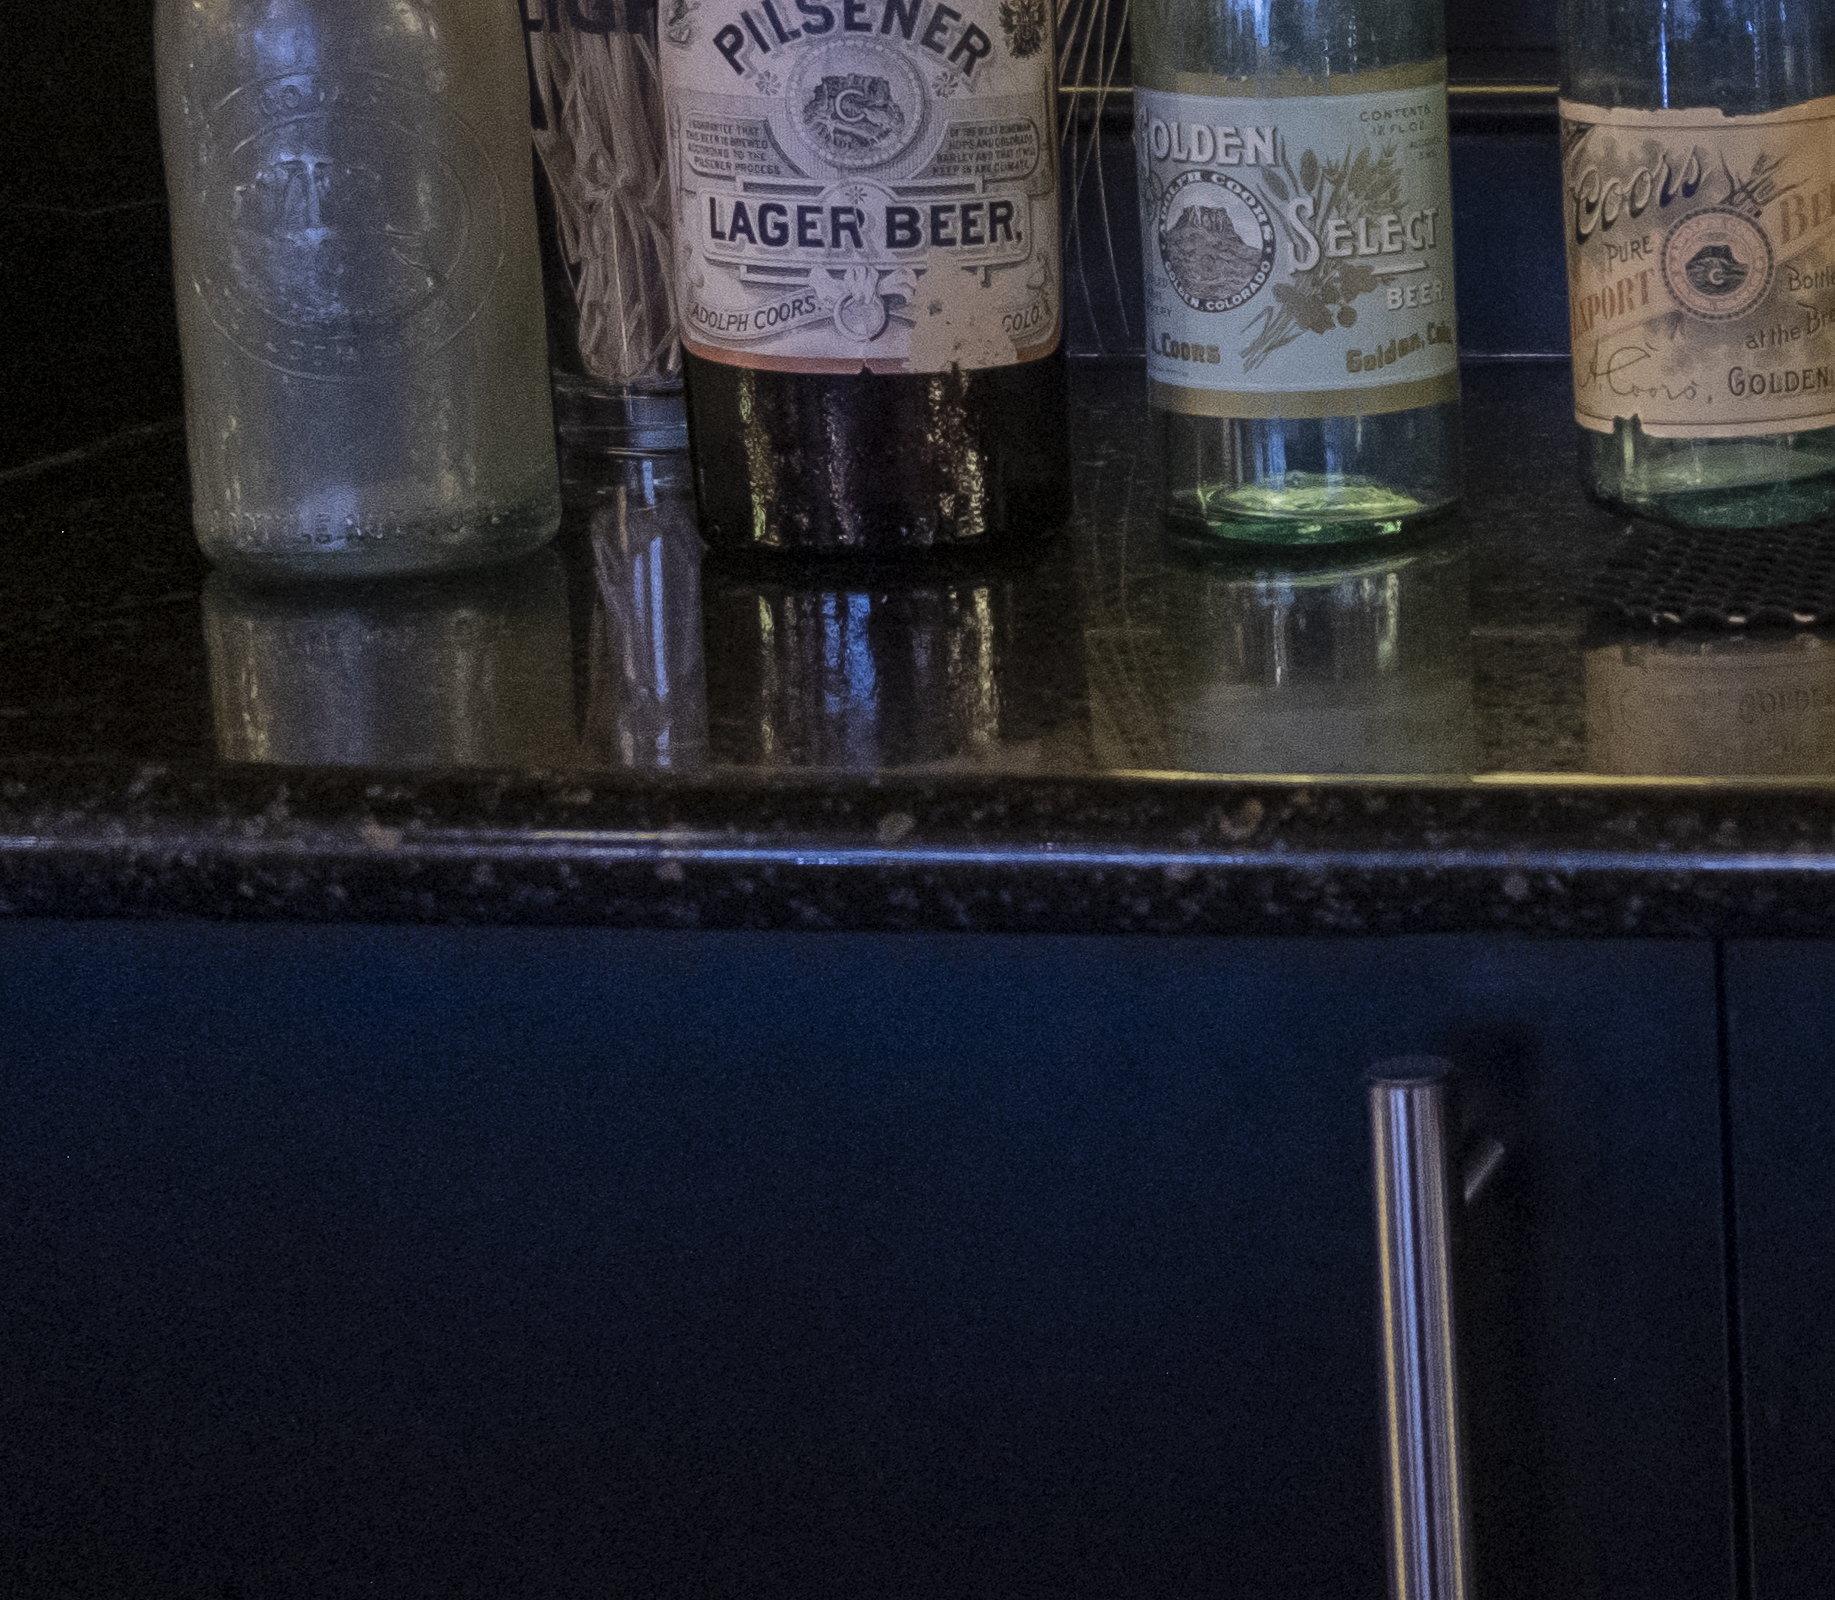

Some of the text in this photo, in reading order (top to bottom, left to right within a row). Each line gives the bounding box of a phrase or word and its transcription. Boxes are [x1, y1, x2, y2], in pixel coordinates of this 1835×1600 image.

[834, 88, 867, 122] C
[1359, 103, 1432, 123] CONTENTS
[1571, 145, 1708, 246] Coors
[709, 197, 1024, 250] LAGER BEER,
[1603, 236, 1653, 274] PURE
[1205, 260, 1272, 312] COLORADO
[1386, 278, 1446, 311] BEER
[689, 303, 749, 333] ADOLPH
[1745, 330, 1766, 350] at
[1769, 323, 1802, 347] the
